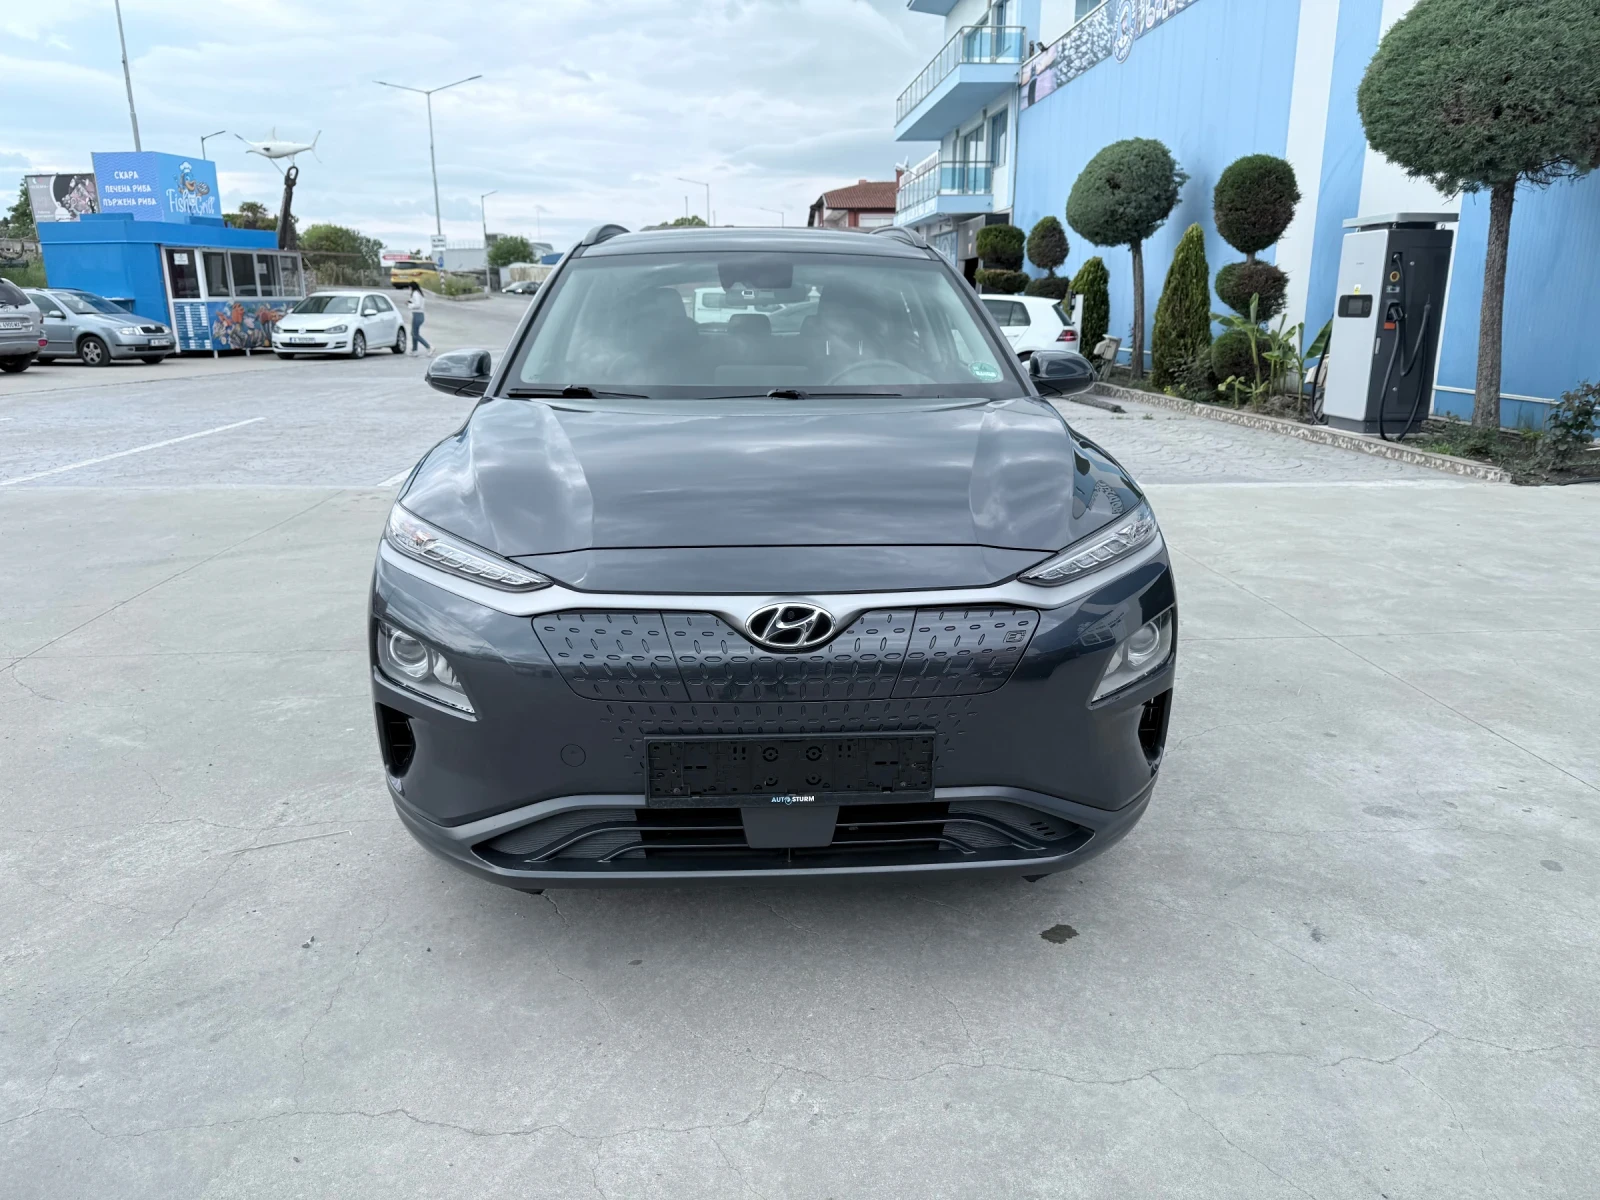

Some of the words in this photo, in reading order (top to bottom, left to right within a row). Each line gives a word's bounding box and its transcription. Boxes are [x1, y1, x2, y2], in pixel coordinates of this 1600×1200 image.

[114, 170, 139, 180] СКАРА
[105, 184, 132, 193] ПЕЧЕНА
[132, 184, 152, 193] РИБА
[103, 198, 137, 207] ПЪРЖЕНА
[137, 198, 157, 206] РИБА
[166, 188, 191, 213] Fish
[195, 195, 215, 215] Grill
